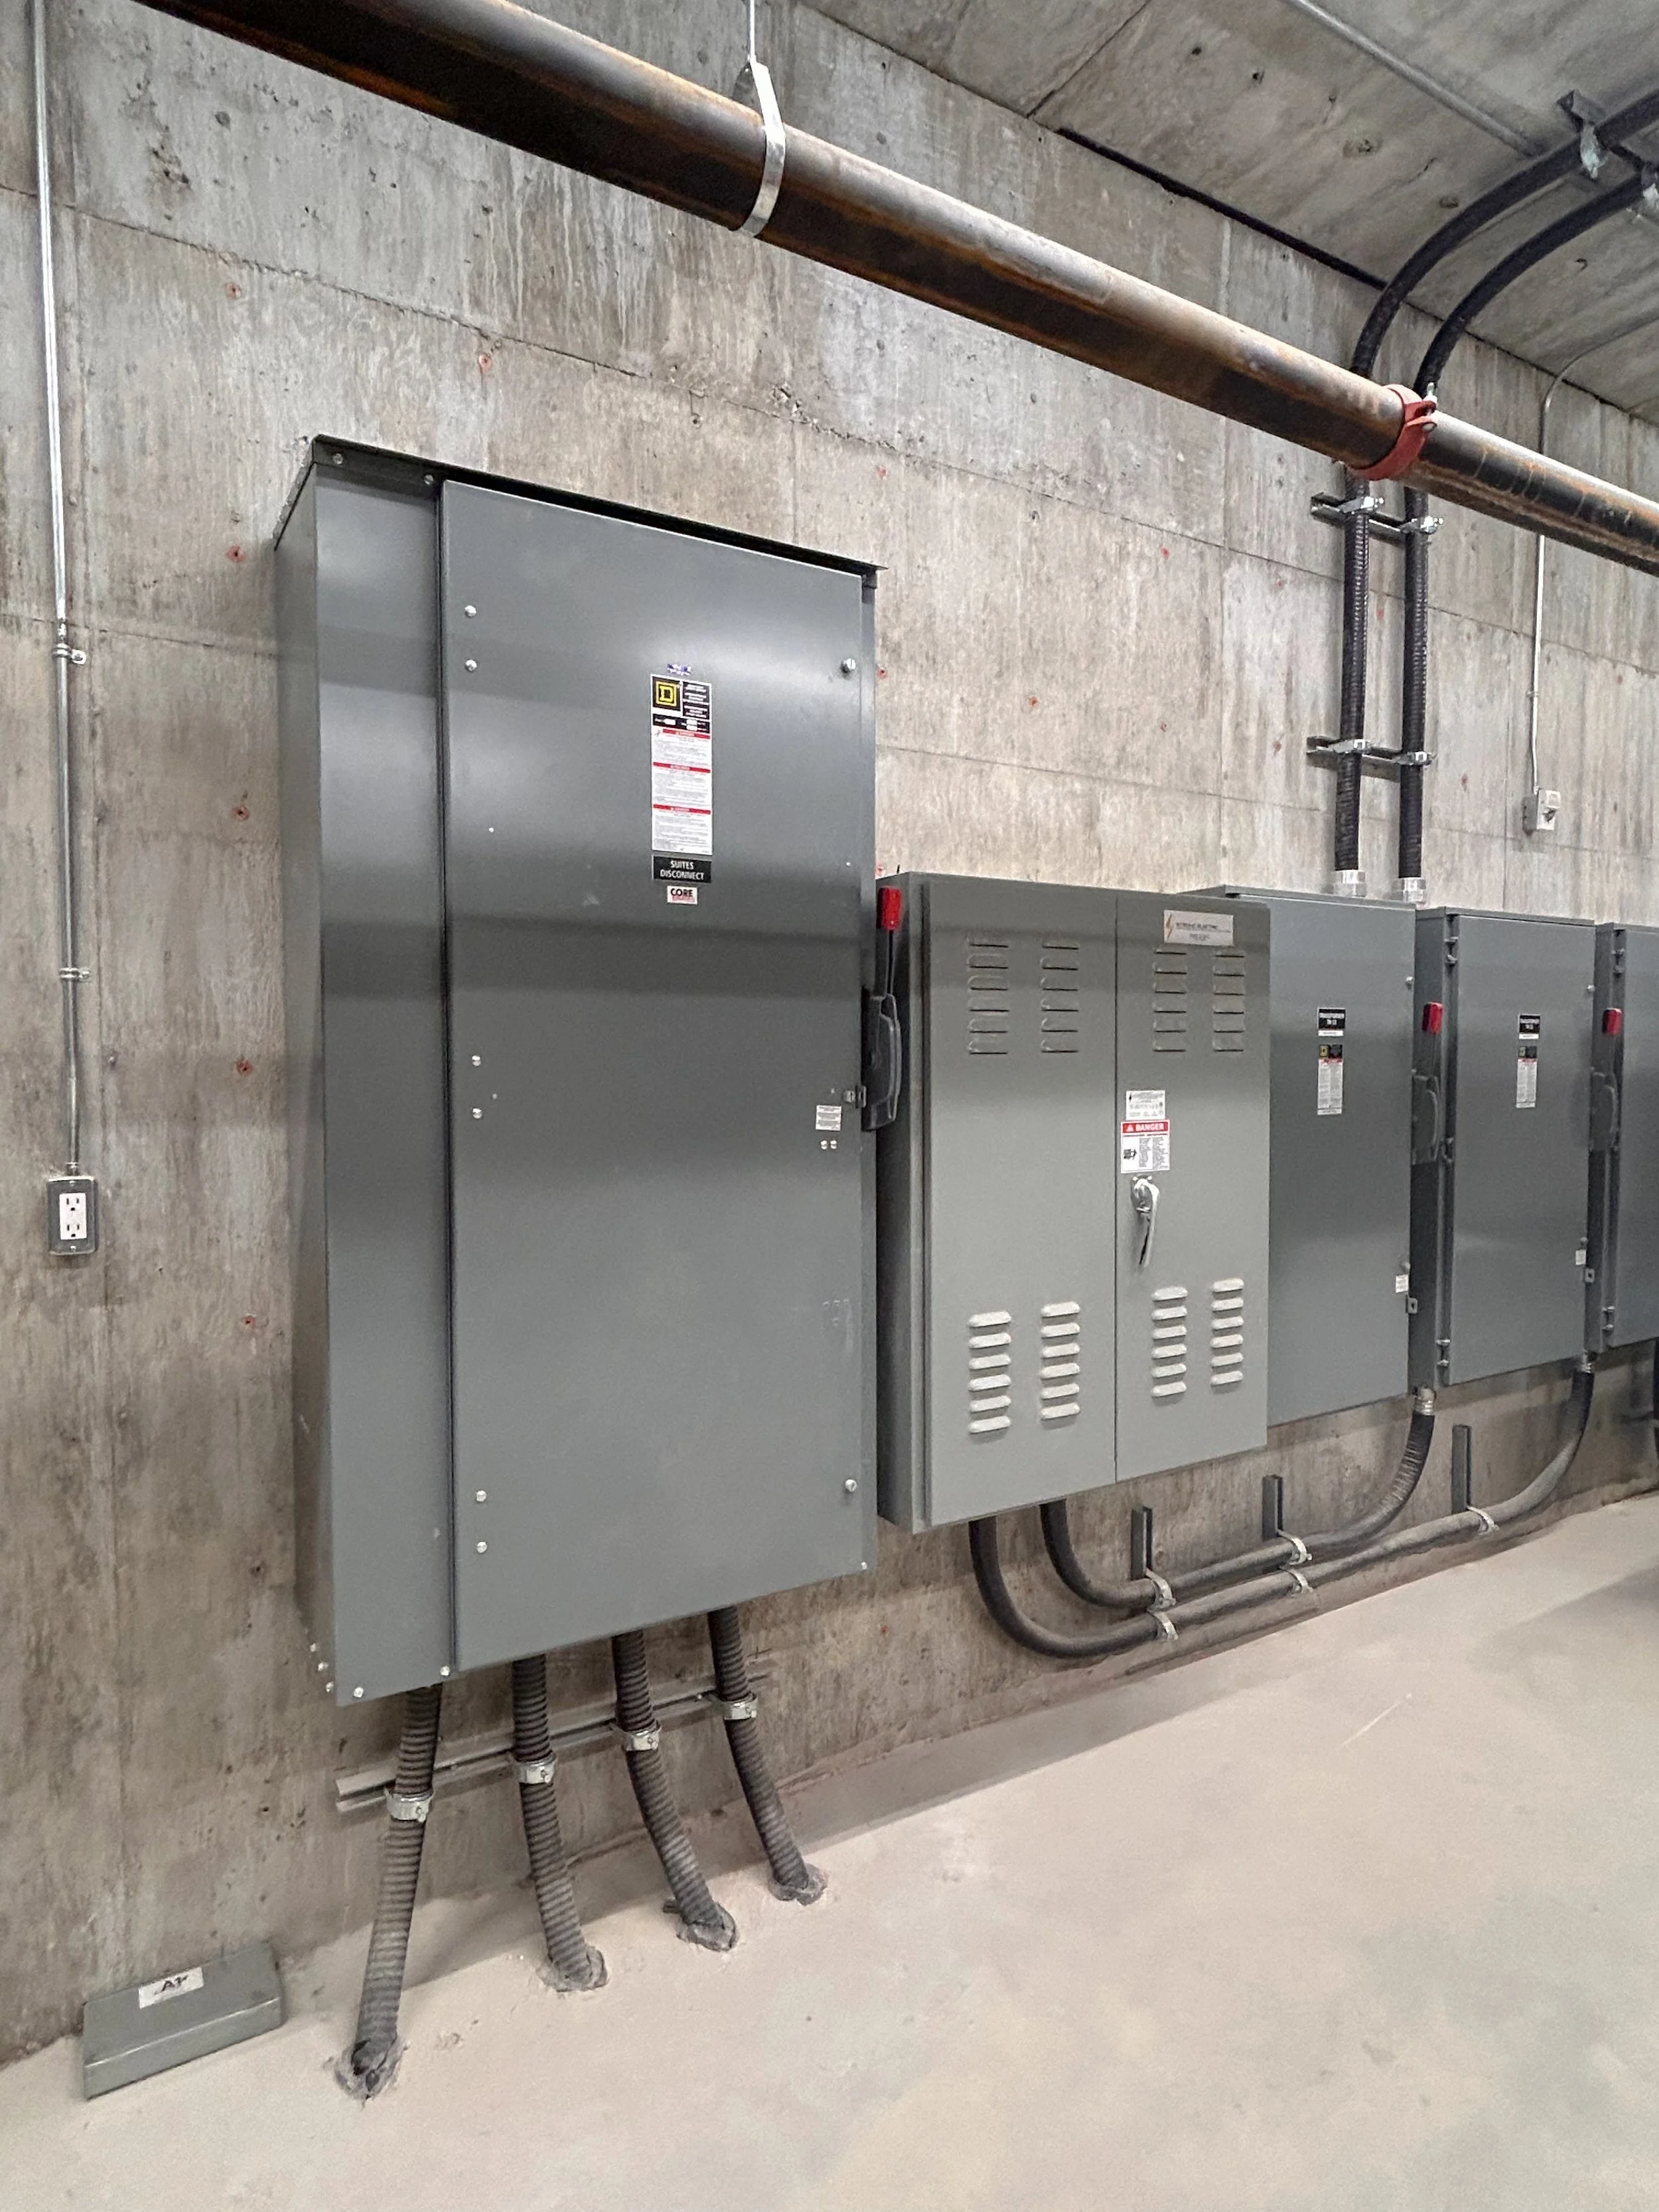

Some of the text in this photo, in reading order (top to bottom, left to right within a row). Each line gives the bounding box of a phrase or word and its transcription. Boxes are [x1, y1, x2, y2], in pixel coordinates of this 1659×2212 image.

[670, 860, 695, 870] SUITES
[660, 869, 705, 880] DISCONNECT
[670, 888, 694, 897] CORE
[1135, 1122, 1165, 1132] DANGER
